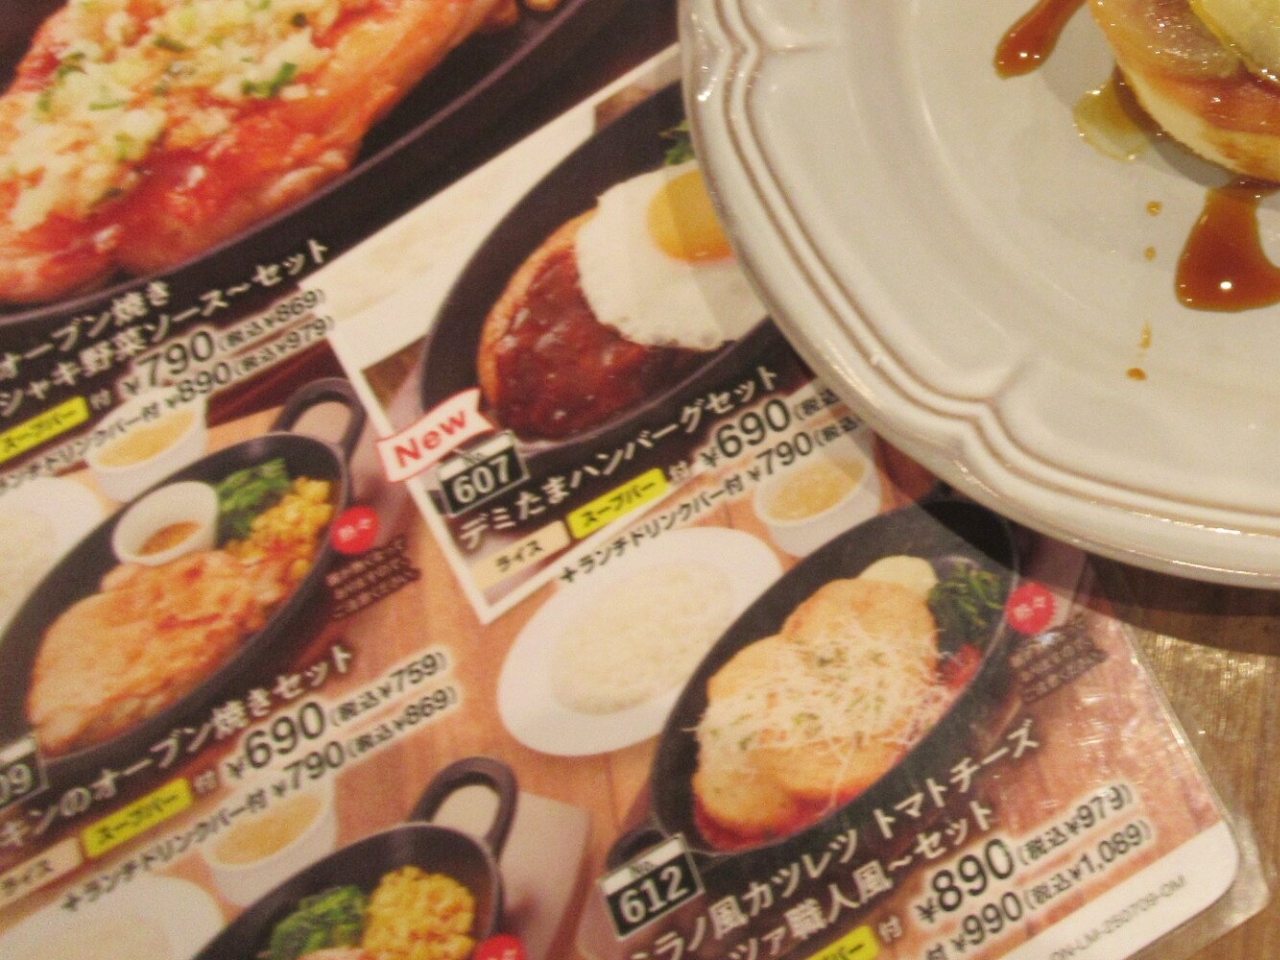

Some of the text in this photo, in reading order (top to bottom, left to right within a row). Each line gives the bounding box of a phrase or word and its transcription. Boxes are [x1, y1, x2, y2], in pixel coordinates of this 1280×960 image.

[121, 330, 217, 395] ¥790
[166, 361, 233, 409] ¥890
[393, 408, 474, 470] New
[459, 366, 780, 552] デミたまハンバーグセット
[578, 478, 660, 529] スープバー
[700, 396, 792, 468] ¥690
[745, 429, 814, 487] ¥790
[449, 452, 513, 506] 607
[493, 537, 547, 573] ライス
[96, 793, 180, 845] スープバー
[225, 701, 326, 780] ¥690
[272, 740, 346, 799] ¥790
[874, 718, 1040, 842] トマトチーズ
[617, 865, 690, 924] 612
[914, 838, 1015, 924] ¥890
[950, 891, 1024, 953] ¥990
